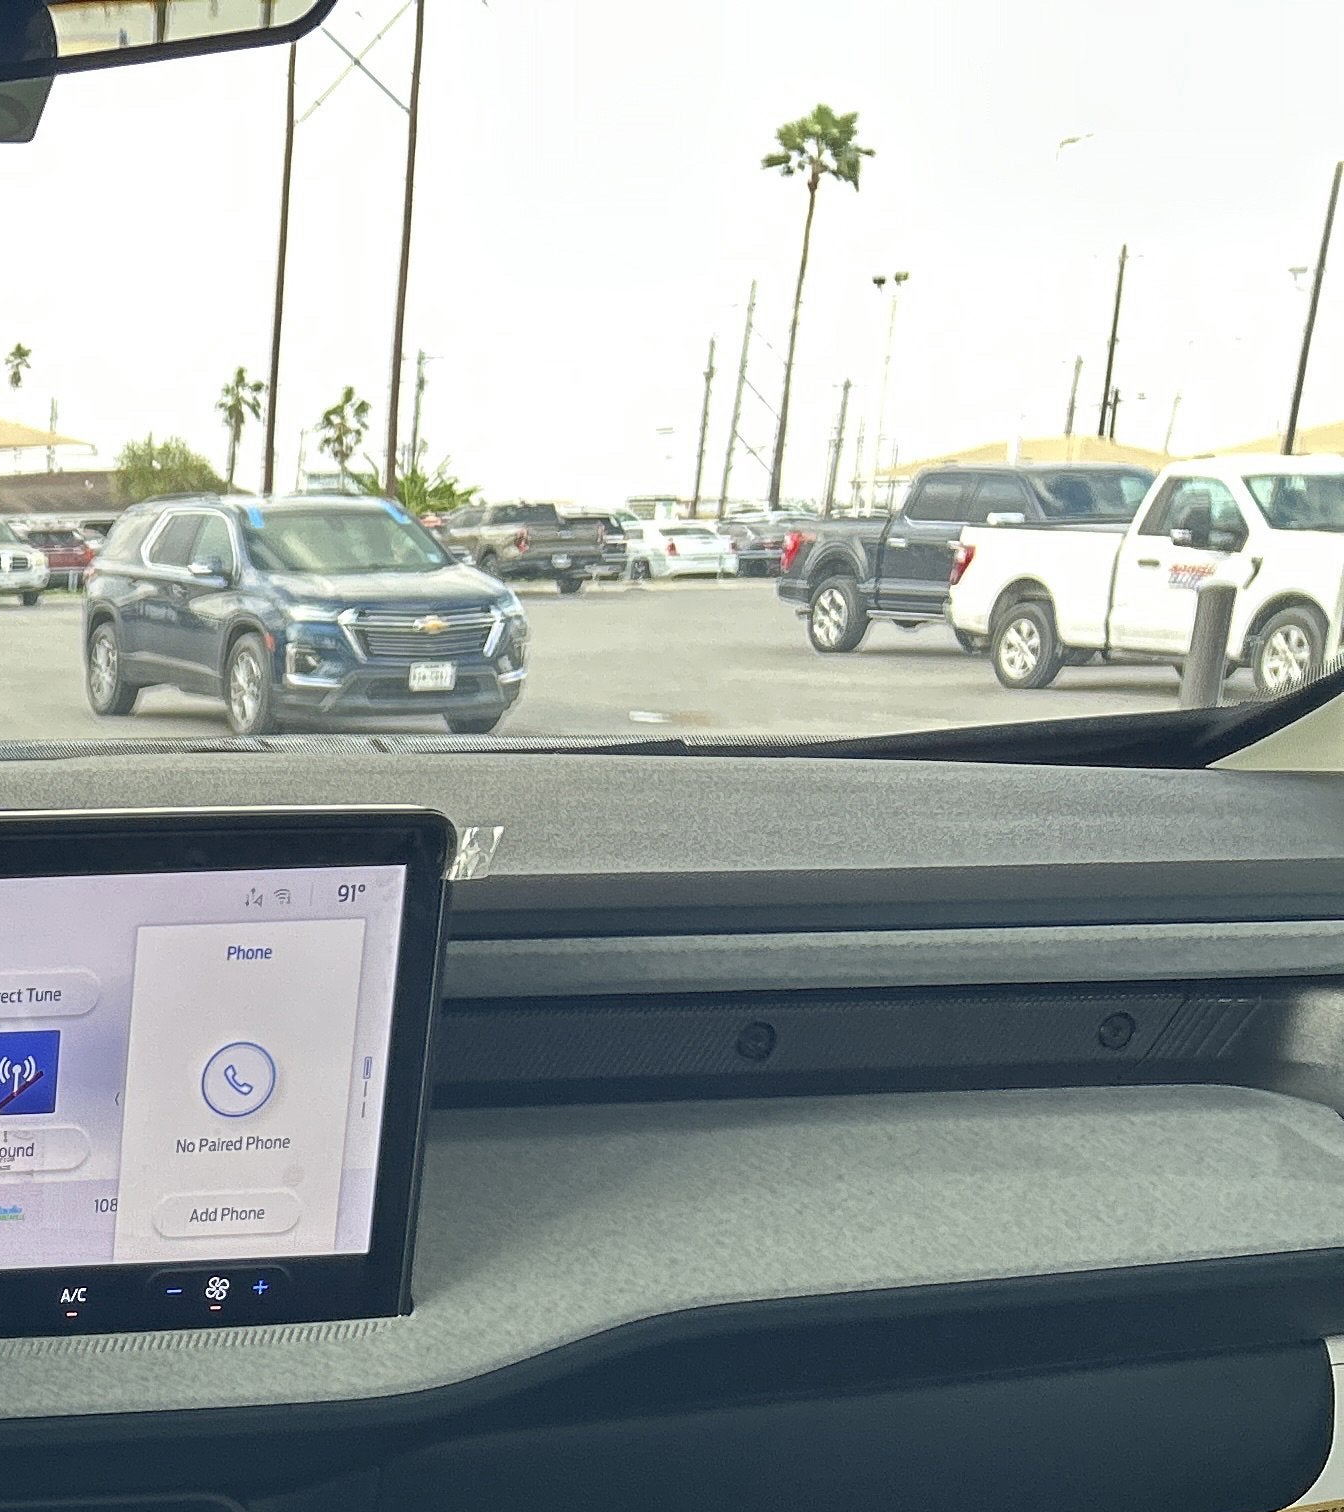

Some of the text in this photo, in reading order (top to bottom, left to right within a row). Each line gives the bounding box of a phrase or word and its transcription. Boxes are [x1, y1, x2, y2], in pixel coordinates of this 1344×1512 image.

[227, 945, 272, 961] Phone
[26, 987, 62, 1003] Tune
[176, 1135, 290, 1153] No Paired Phone
[189, 1207, 265, 1223] Add Phone
[61, 1287, 87, 1302] A/C
